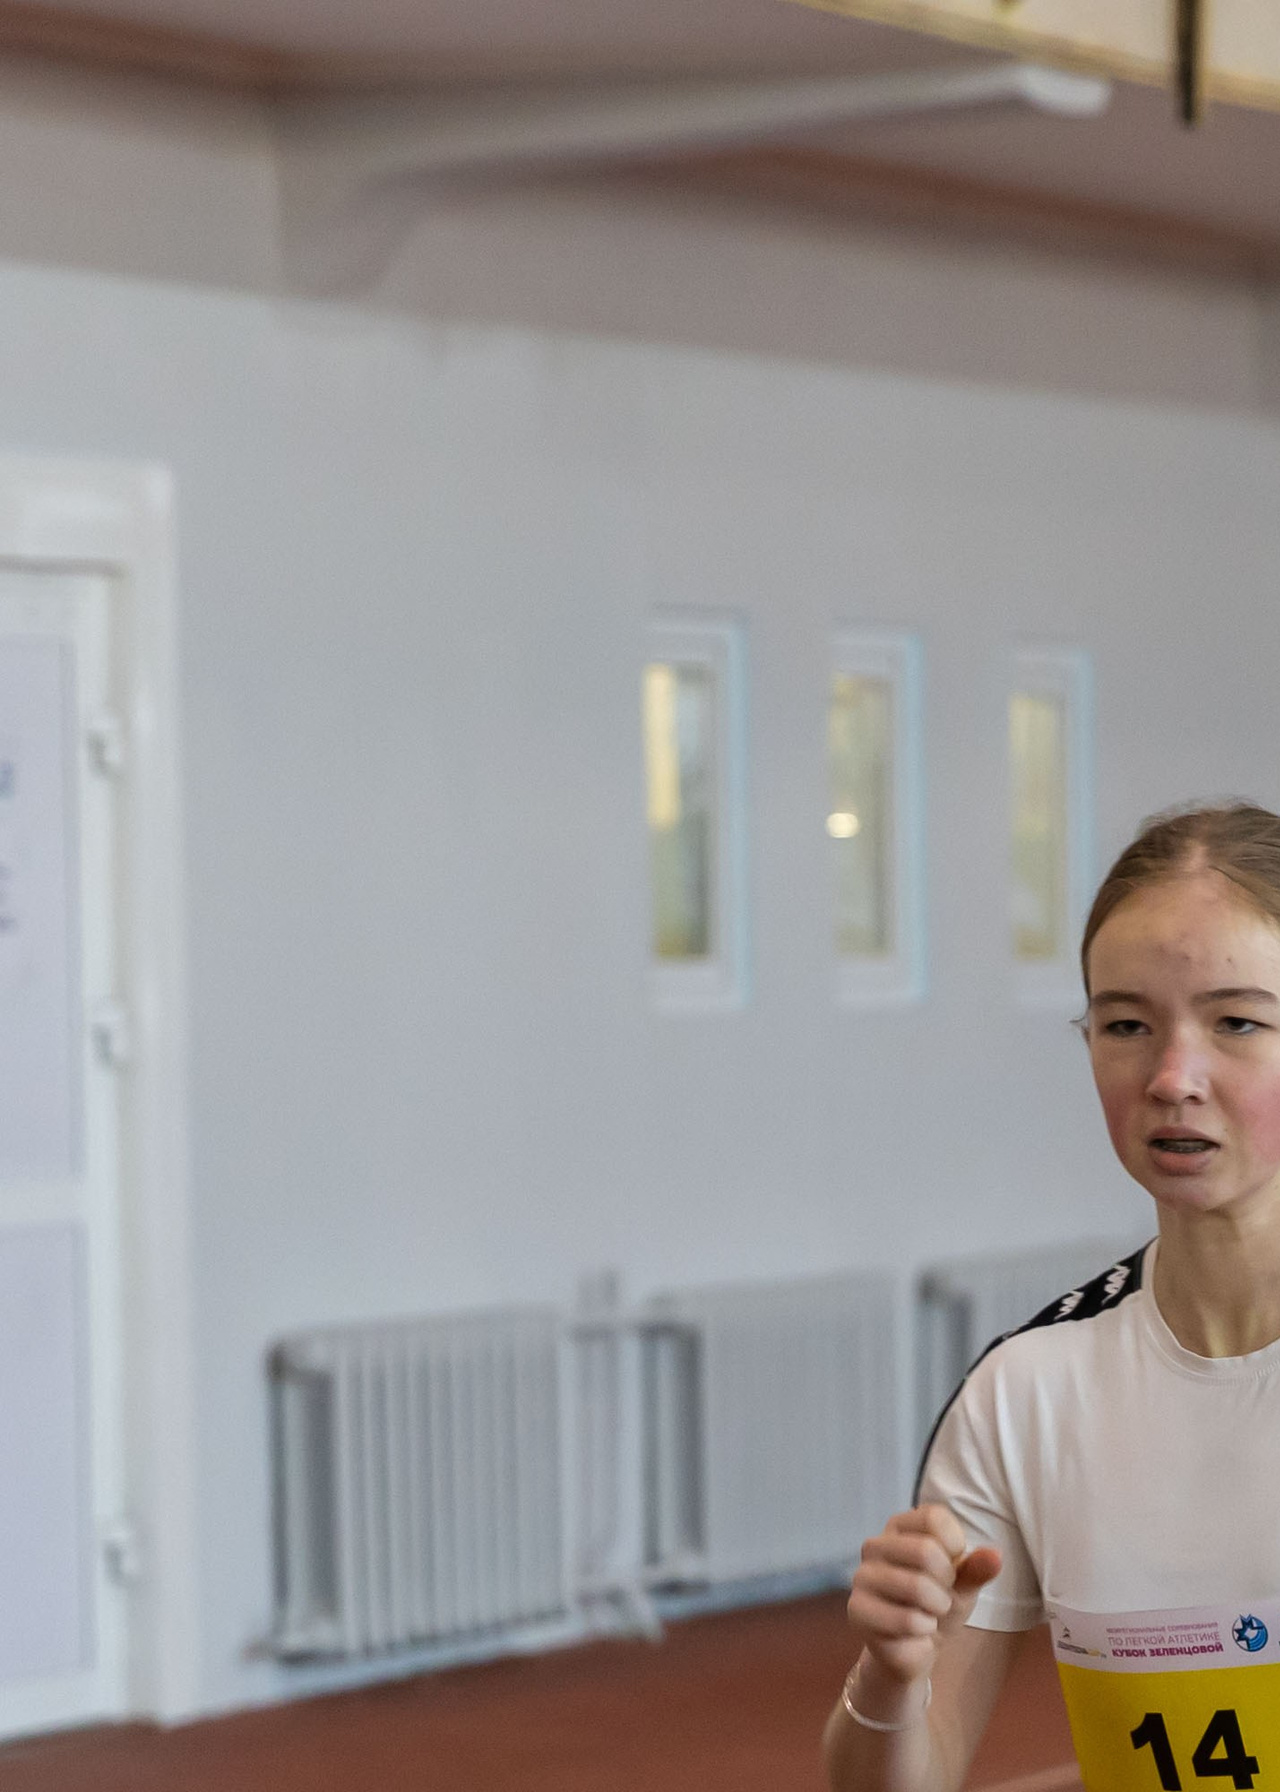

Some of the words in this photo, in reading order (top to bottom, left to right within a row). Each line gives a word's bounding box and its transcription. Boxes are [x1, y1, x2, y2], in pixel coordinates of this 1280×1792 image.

[1107, 1636, 1123, 1646] ПО
[1125, 1633, 1165, 1646] ЛЕГКОЙ
[1167, 1631, 1220, 1644] АТЛЕТИКЕ
[1111, 1648, 1148, 1658] КУБОК
[1148, 1642, 1225, 1657] ЗЕЛЕНЦОВОЙ
[1129, 1708, 1260, 1792] 14
